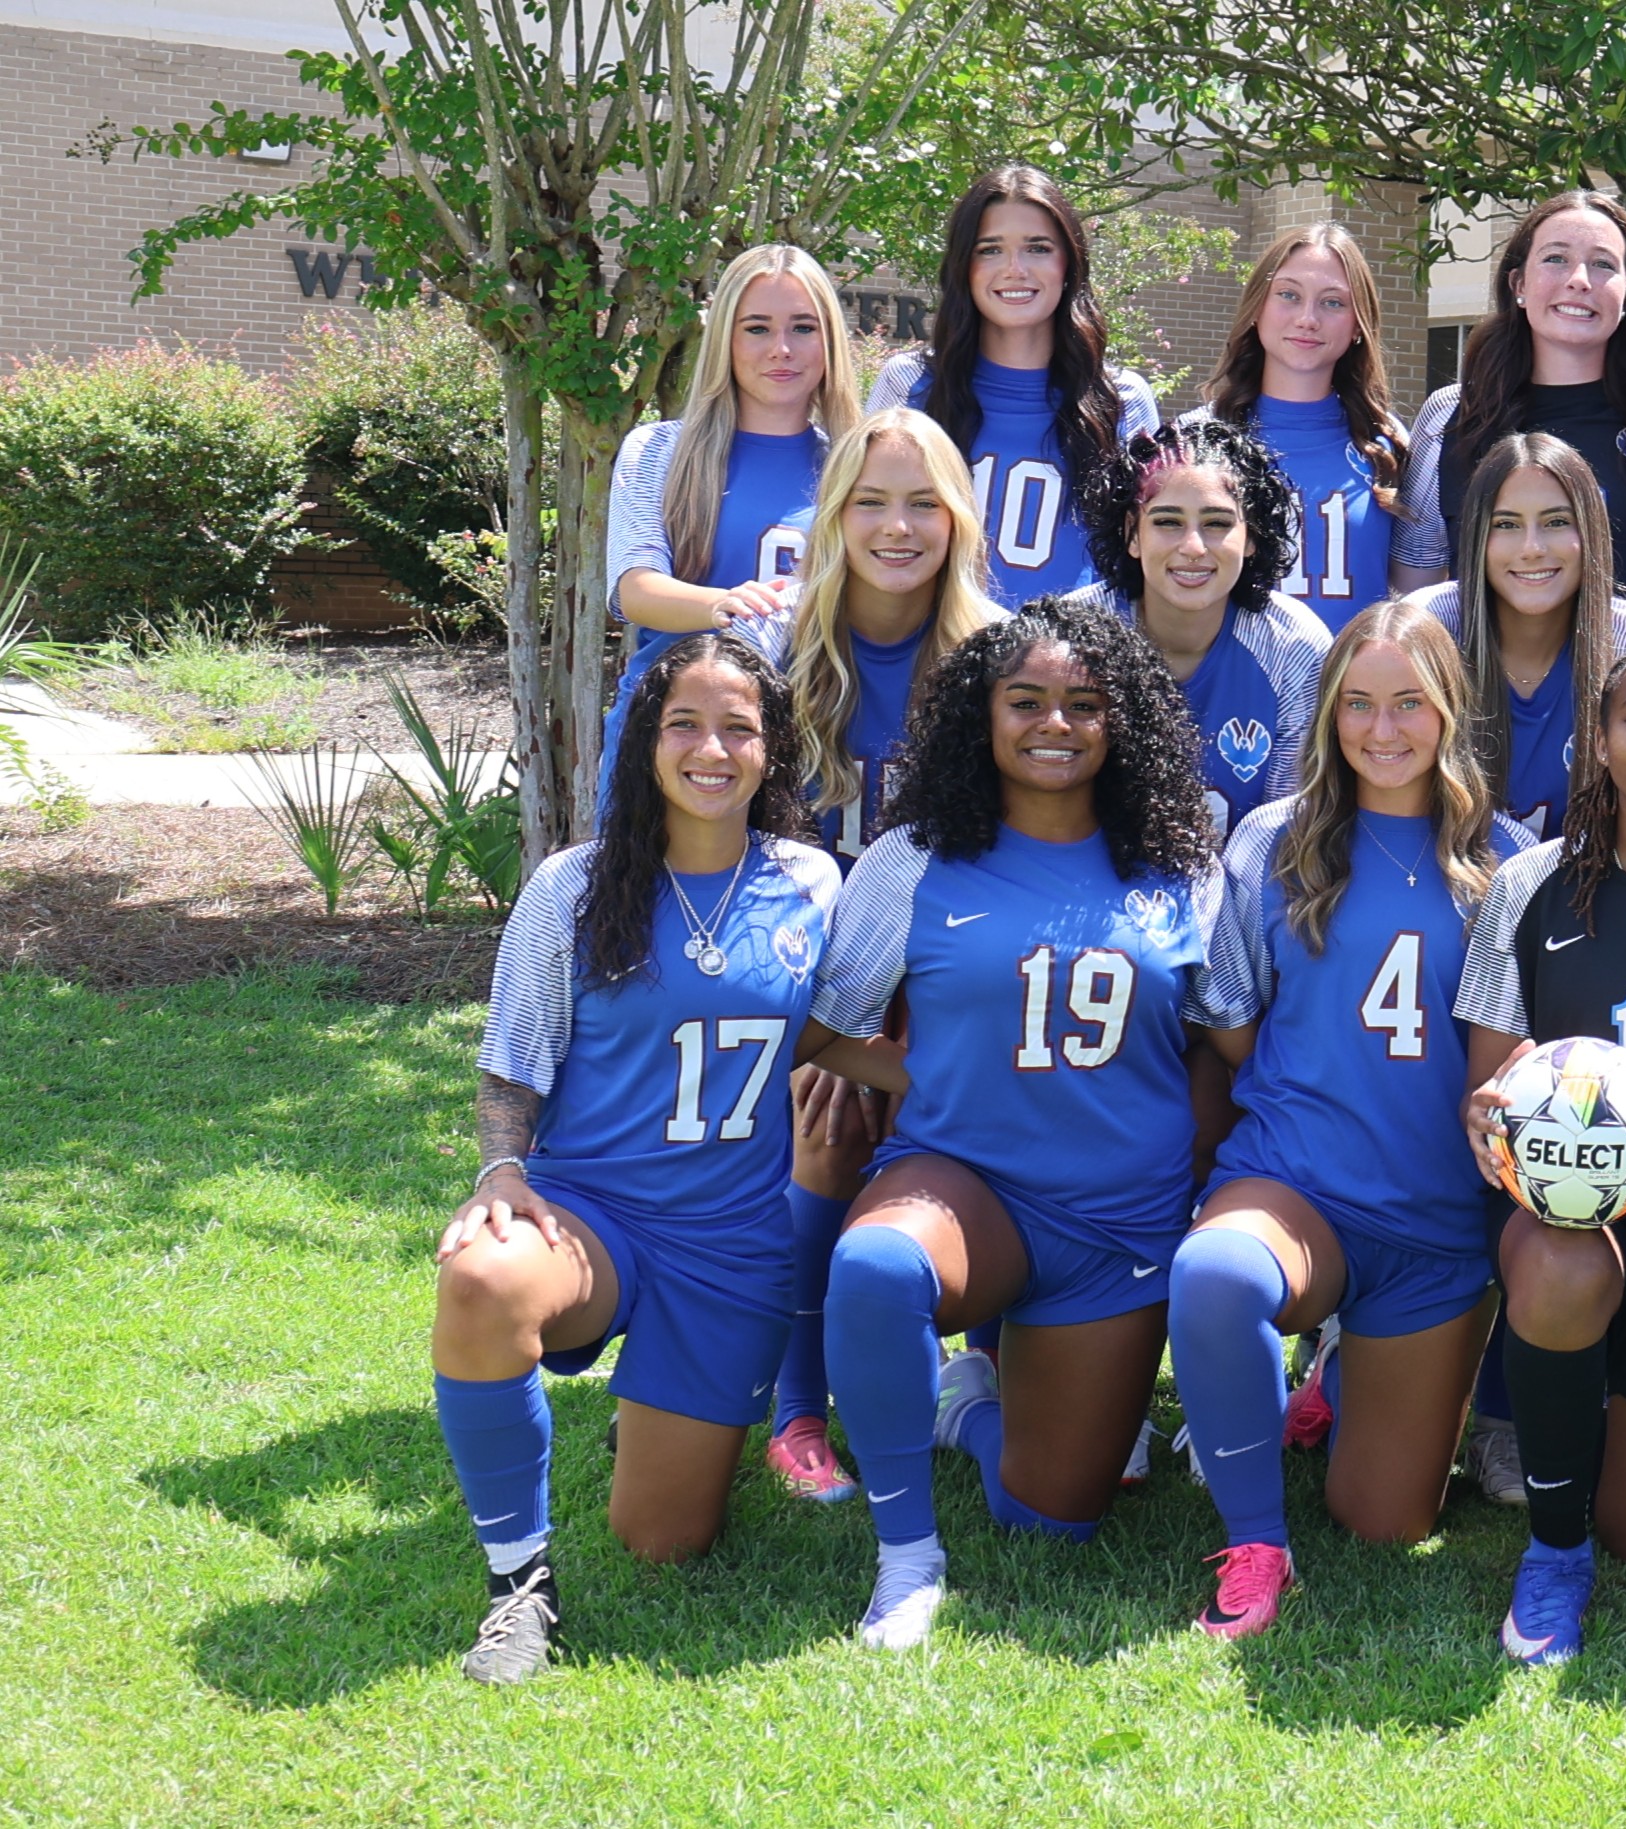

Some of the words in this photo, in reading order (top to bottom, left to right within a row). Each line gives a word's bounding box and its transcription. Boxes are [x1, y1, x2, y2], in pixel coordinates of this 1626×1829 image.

[970, 452, 1064, 572] 10
[1280, 489, 1353, 599] 11
[1014, 944, 1138, 1072] 19
[1358, 930, 1426, 1061] 4
[665, 1015, 789, 1143] 17
[1526, 1137, 1625, 1170] SELECT
